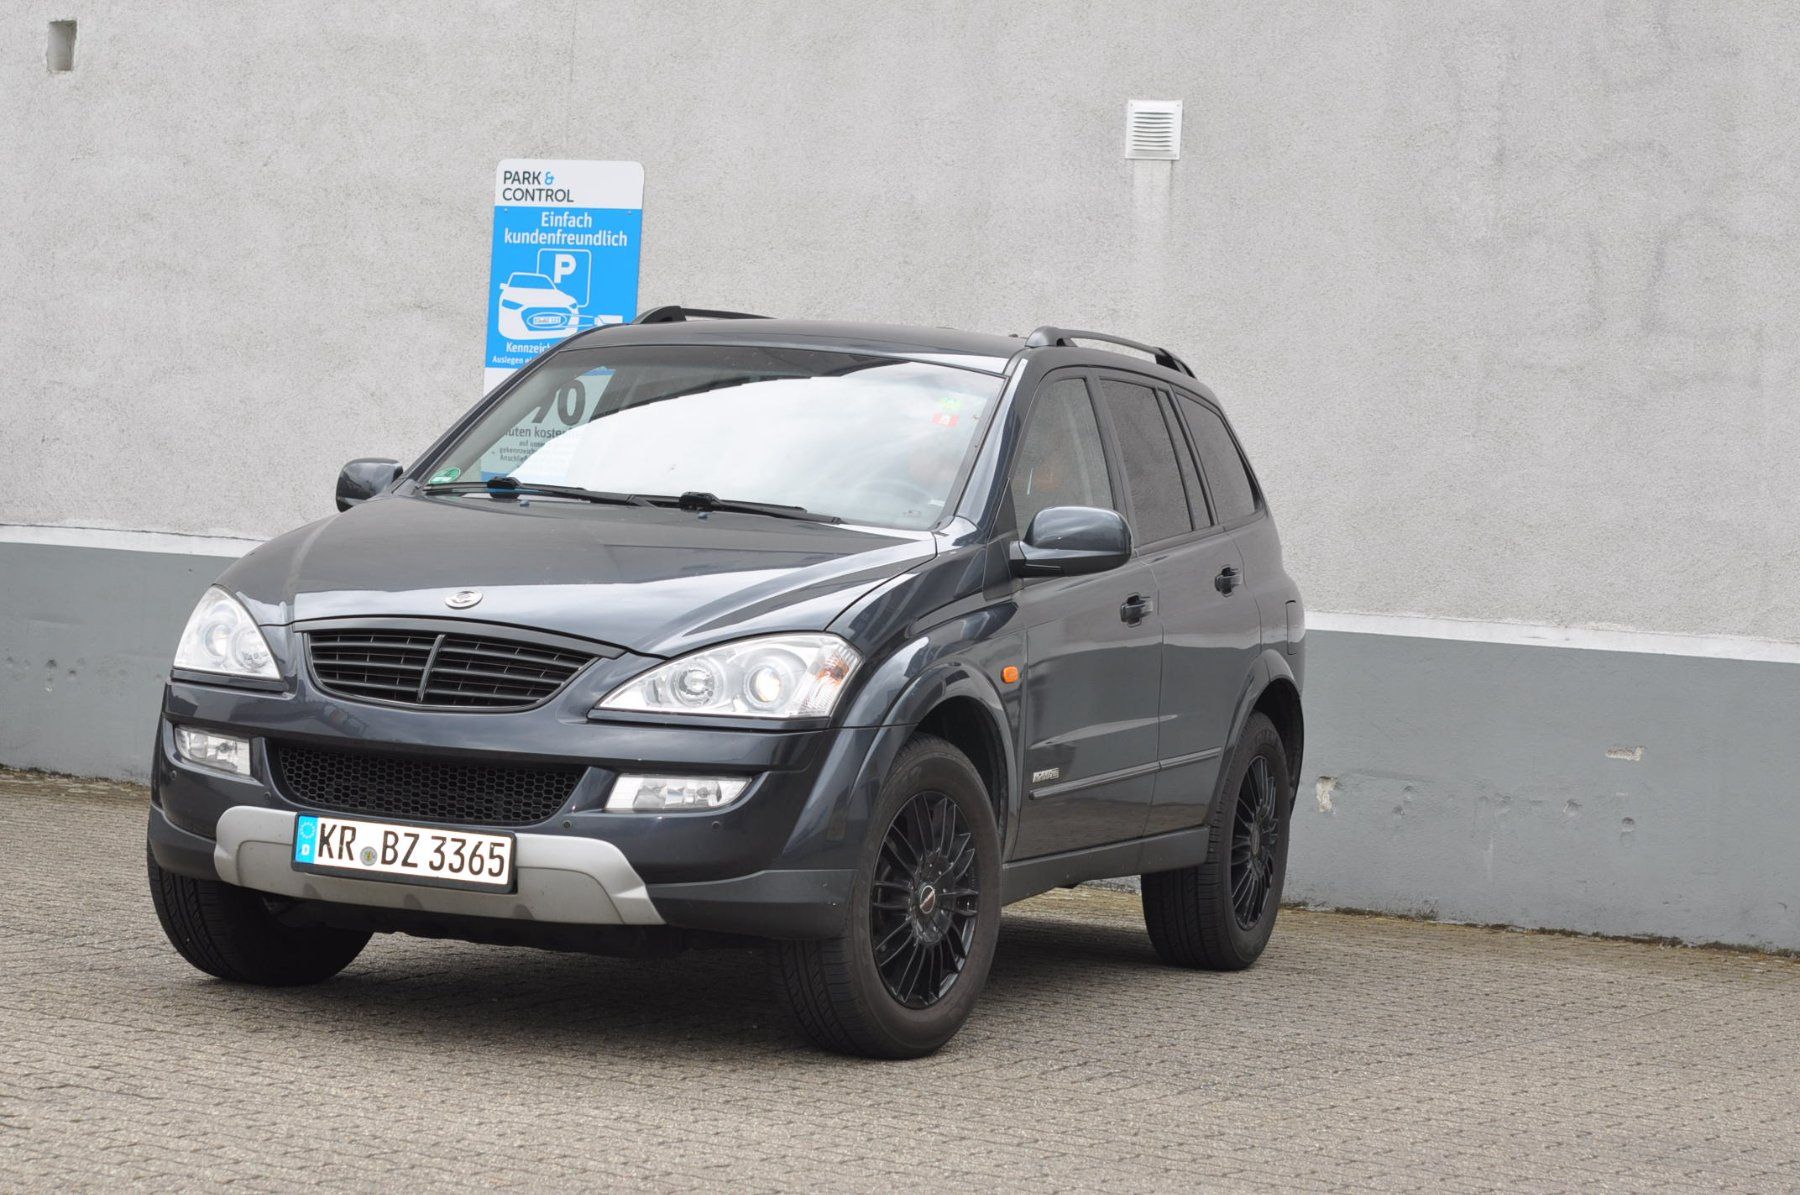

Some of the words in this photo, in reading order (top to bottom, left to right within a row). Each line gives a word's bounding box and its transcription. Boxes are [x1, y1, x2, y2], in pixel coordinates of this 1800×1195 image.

[503, 170, 541, 185] PARK
[544, 171, 555, 185] &
[502, 187, 574, 203] CONTROL
[541, 211, 592, 228] Einfach
[504, 228, 628, 247] kundenfreundlich
[554, 254, 577, 283] P
[301, 844, 309, 856] D
[317, 823, 357, 861] KR
[380, 830, 420, 868] BZ
[428, 835, 505, 877] 3365
